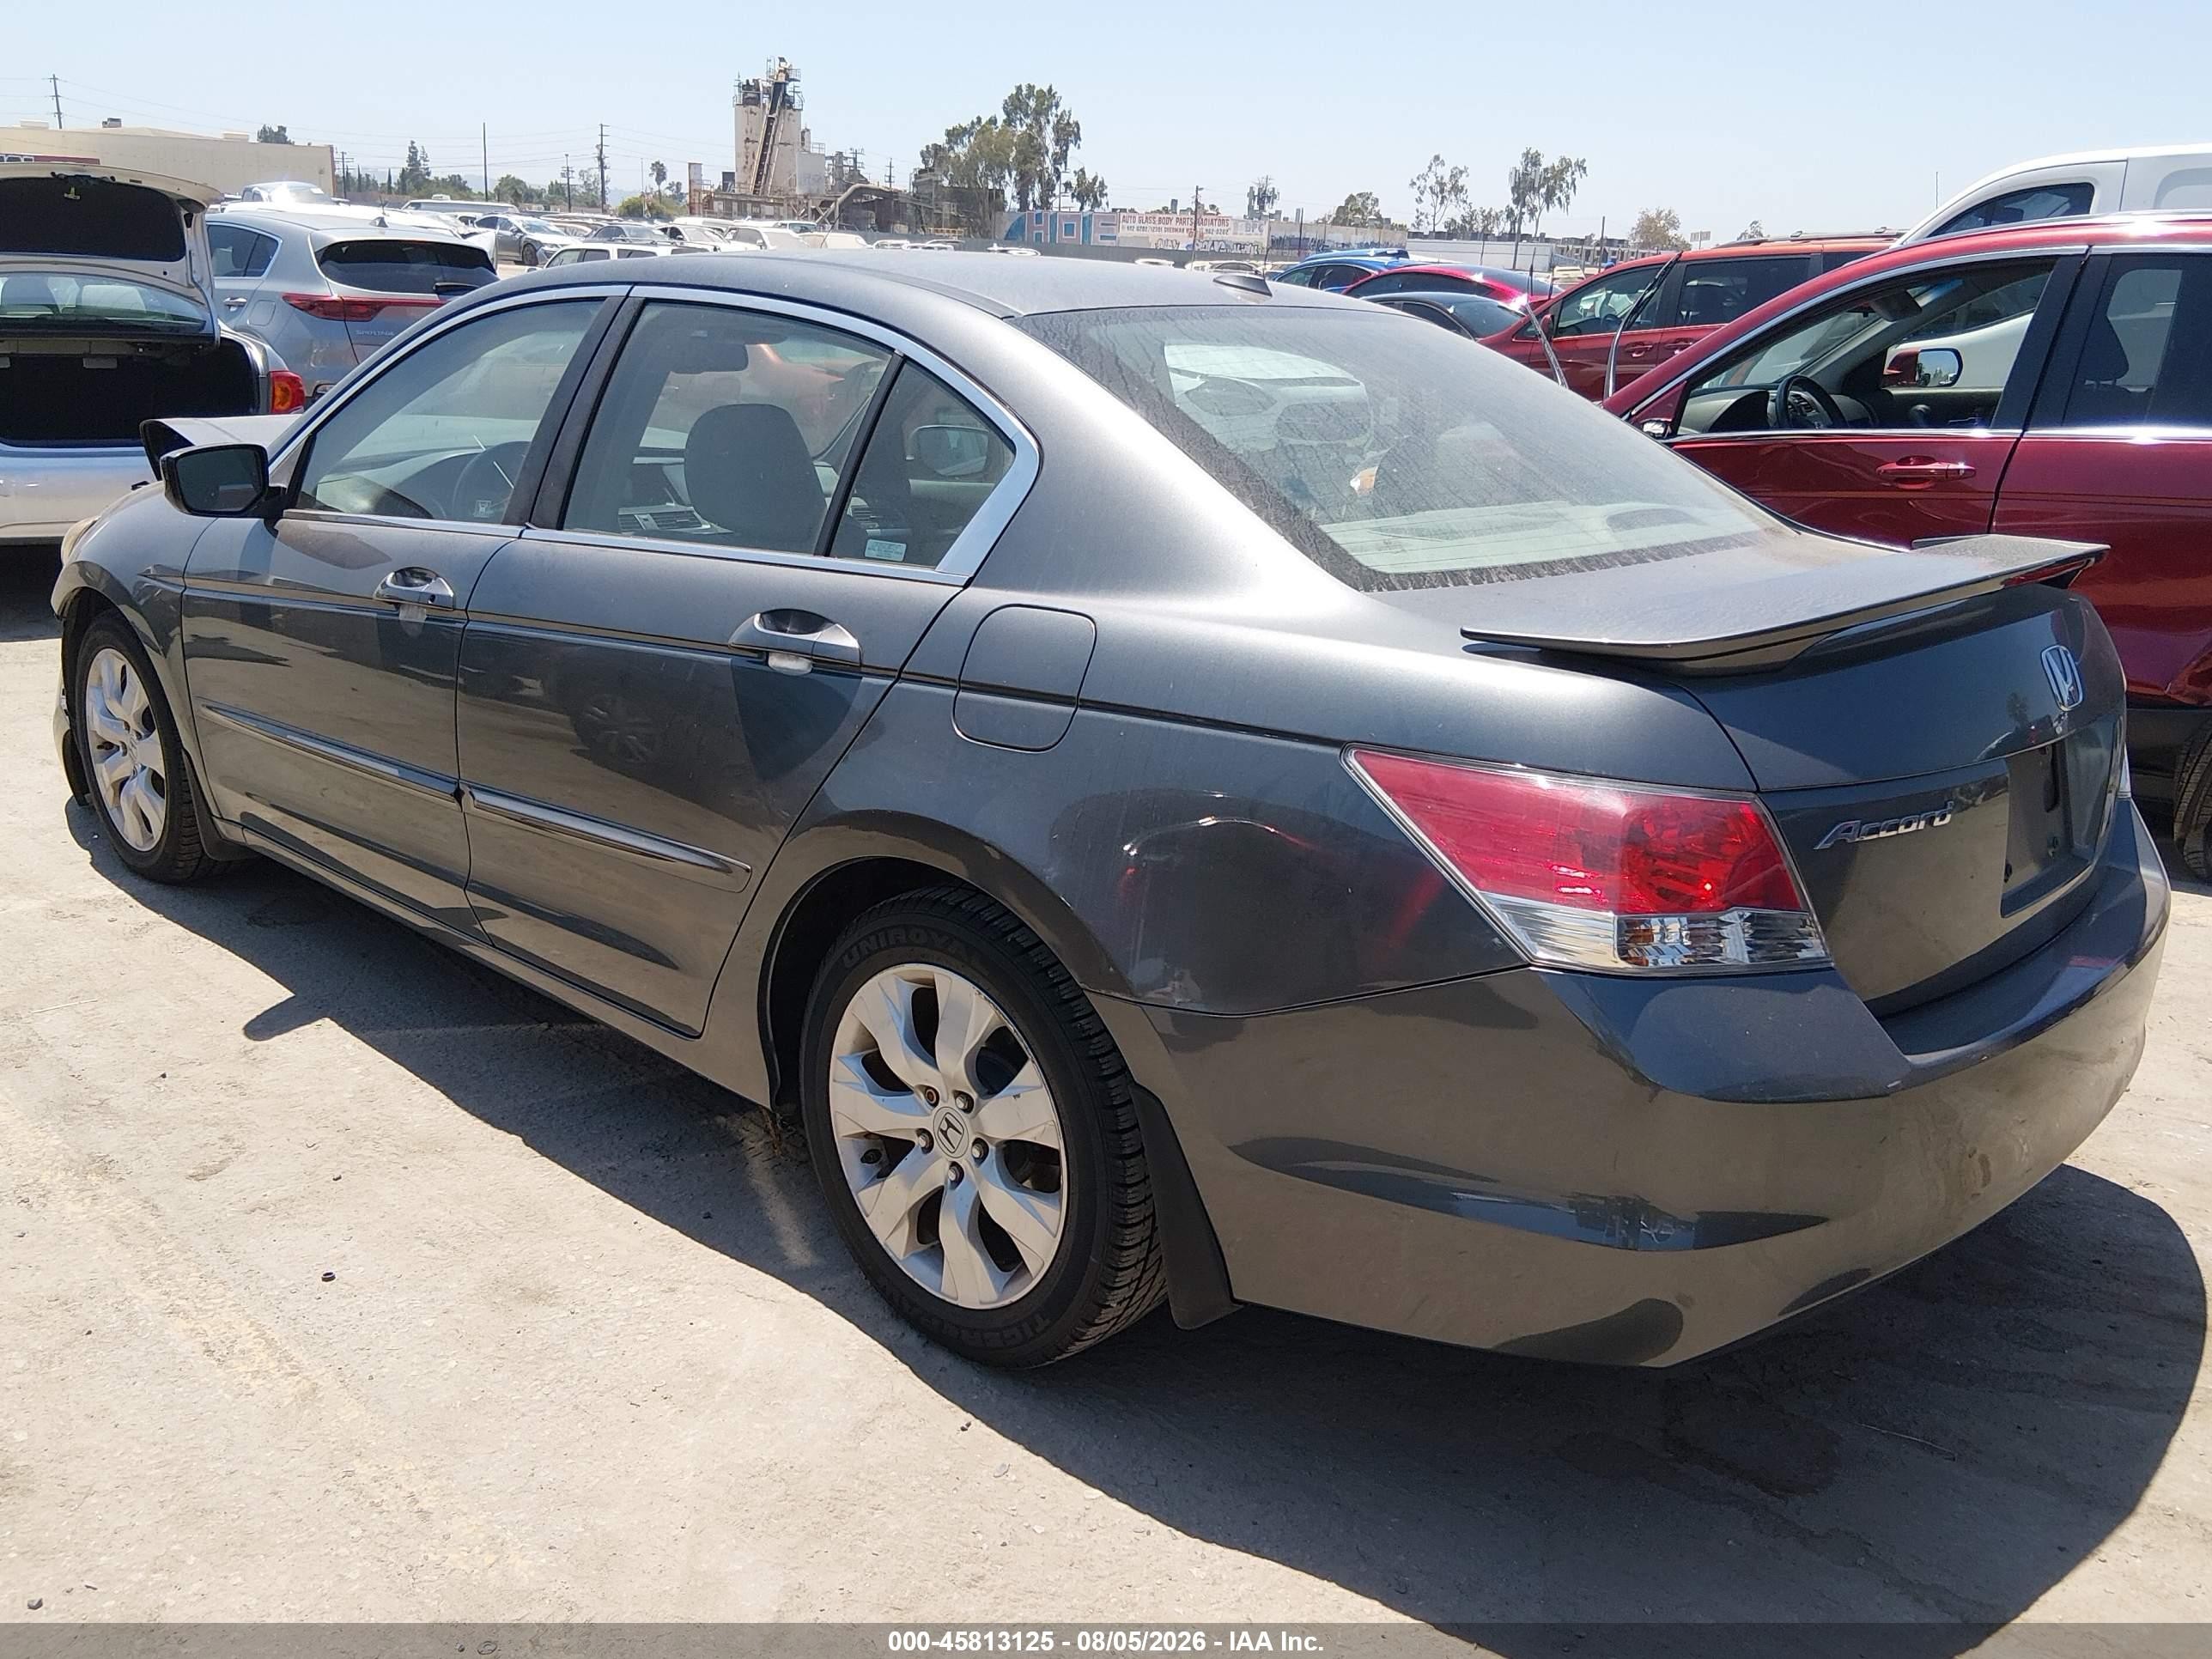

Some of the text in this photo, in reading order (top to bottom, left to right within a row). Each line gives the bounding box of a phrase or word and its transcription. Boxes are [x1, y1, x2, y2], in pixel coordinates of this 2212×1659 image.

[1121, 215, 1136, 224] AUTO
[1138, 216, 1156, 225] GLASS
[1158, 216, 1174, 226] BODY
[1176, 216, 1194, 227] PARTS
[1814, 801, 1954, 850] Accord
